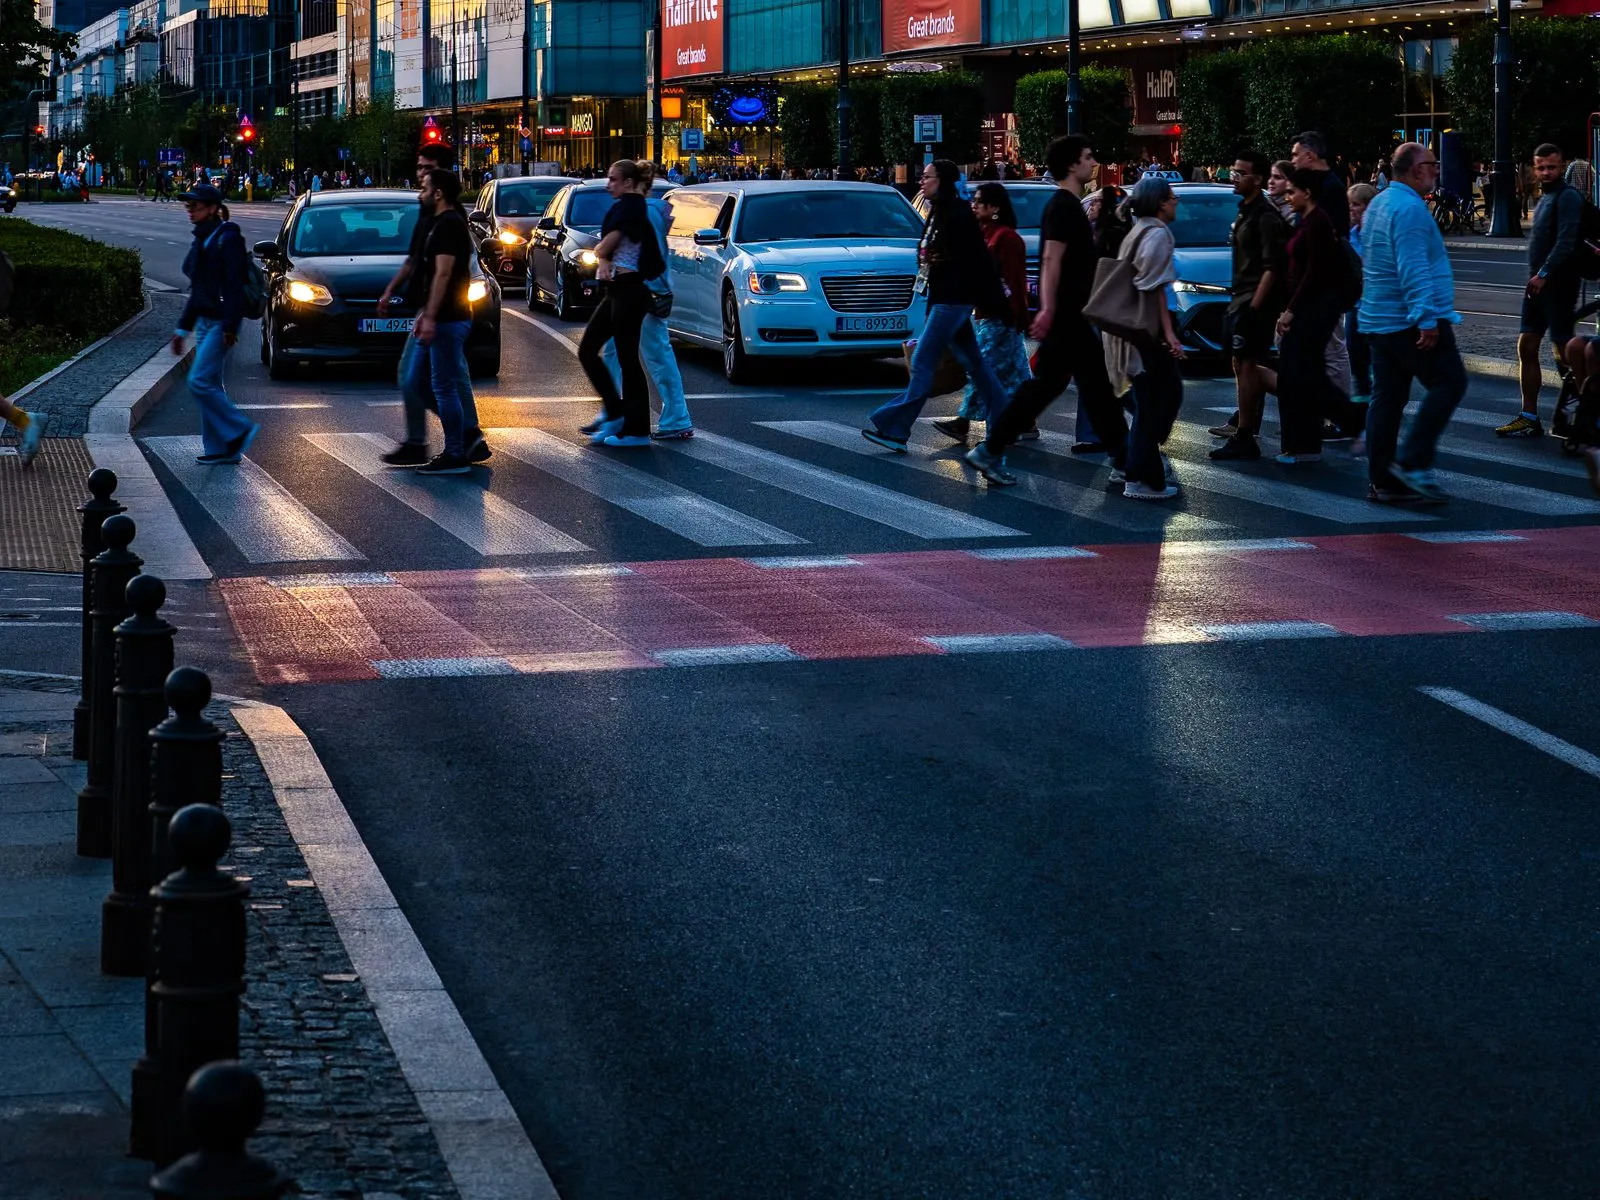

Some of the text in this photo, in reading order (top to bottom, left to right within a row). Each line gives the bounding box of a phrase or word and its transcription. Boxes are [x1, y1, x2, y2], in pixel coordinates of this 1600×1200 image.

[907, 10, 955, 39] Great brands
[676, 43, 707, 66] Great brands
[661, 87, 685, 95] AWA
[571, 113, 593, 132] MANGO
[1146, 171, 1179, 180] TAXI
[365, 319, 414, 332] WL 4945
[846, 317, 904, 331] LC 89936
